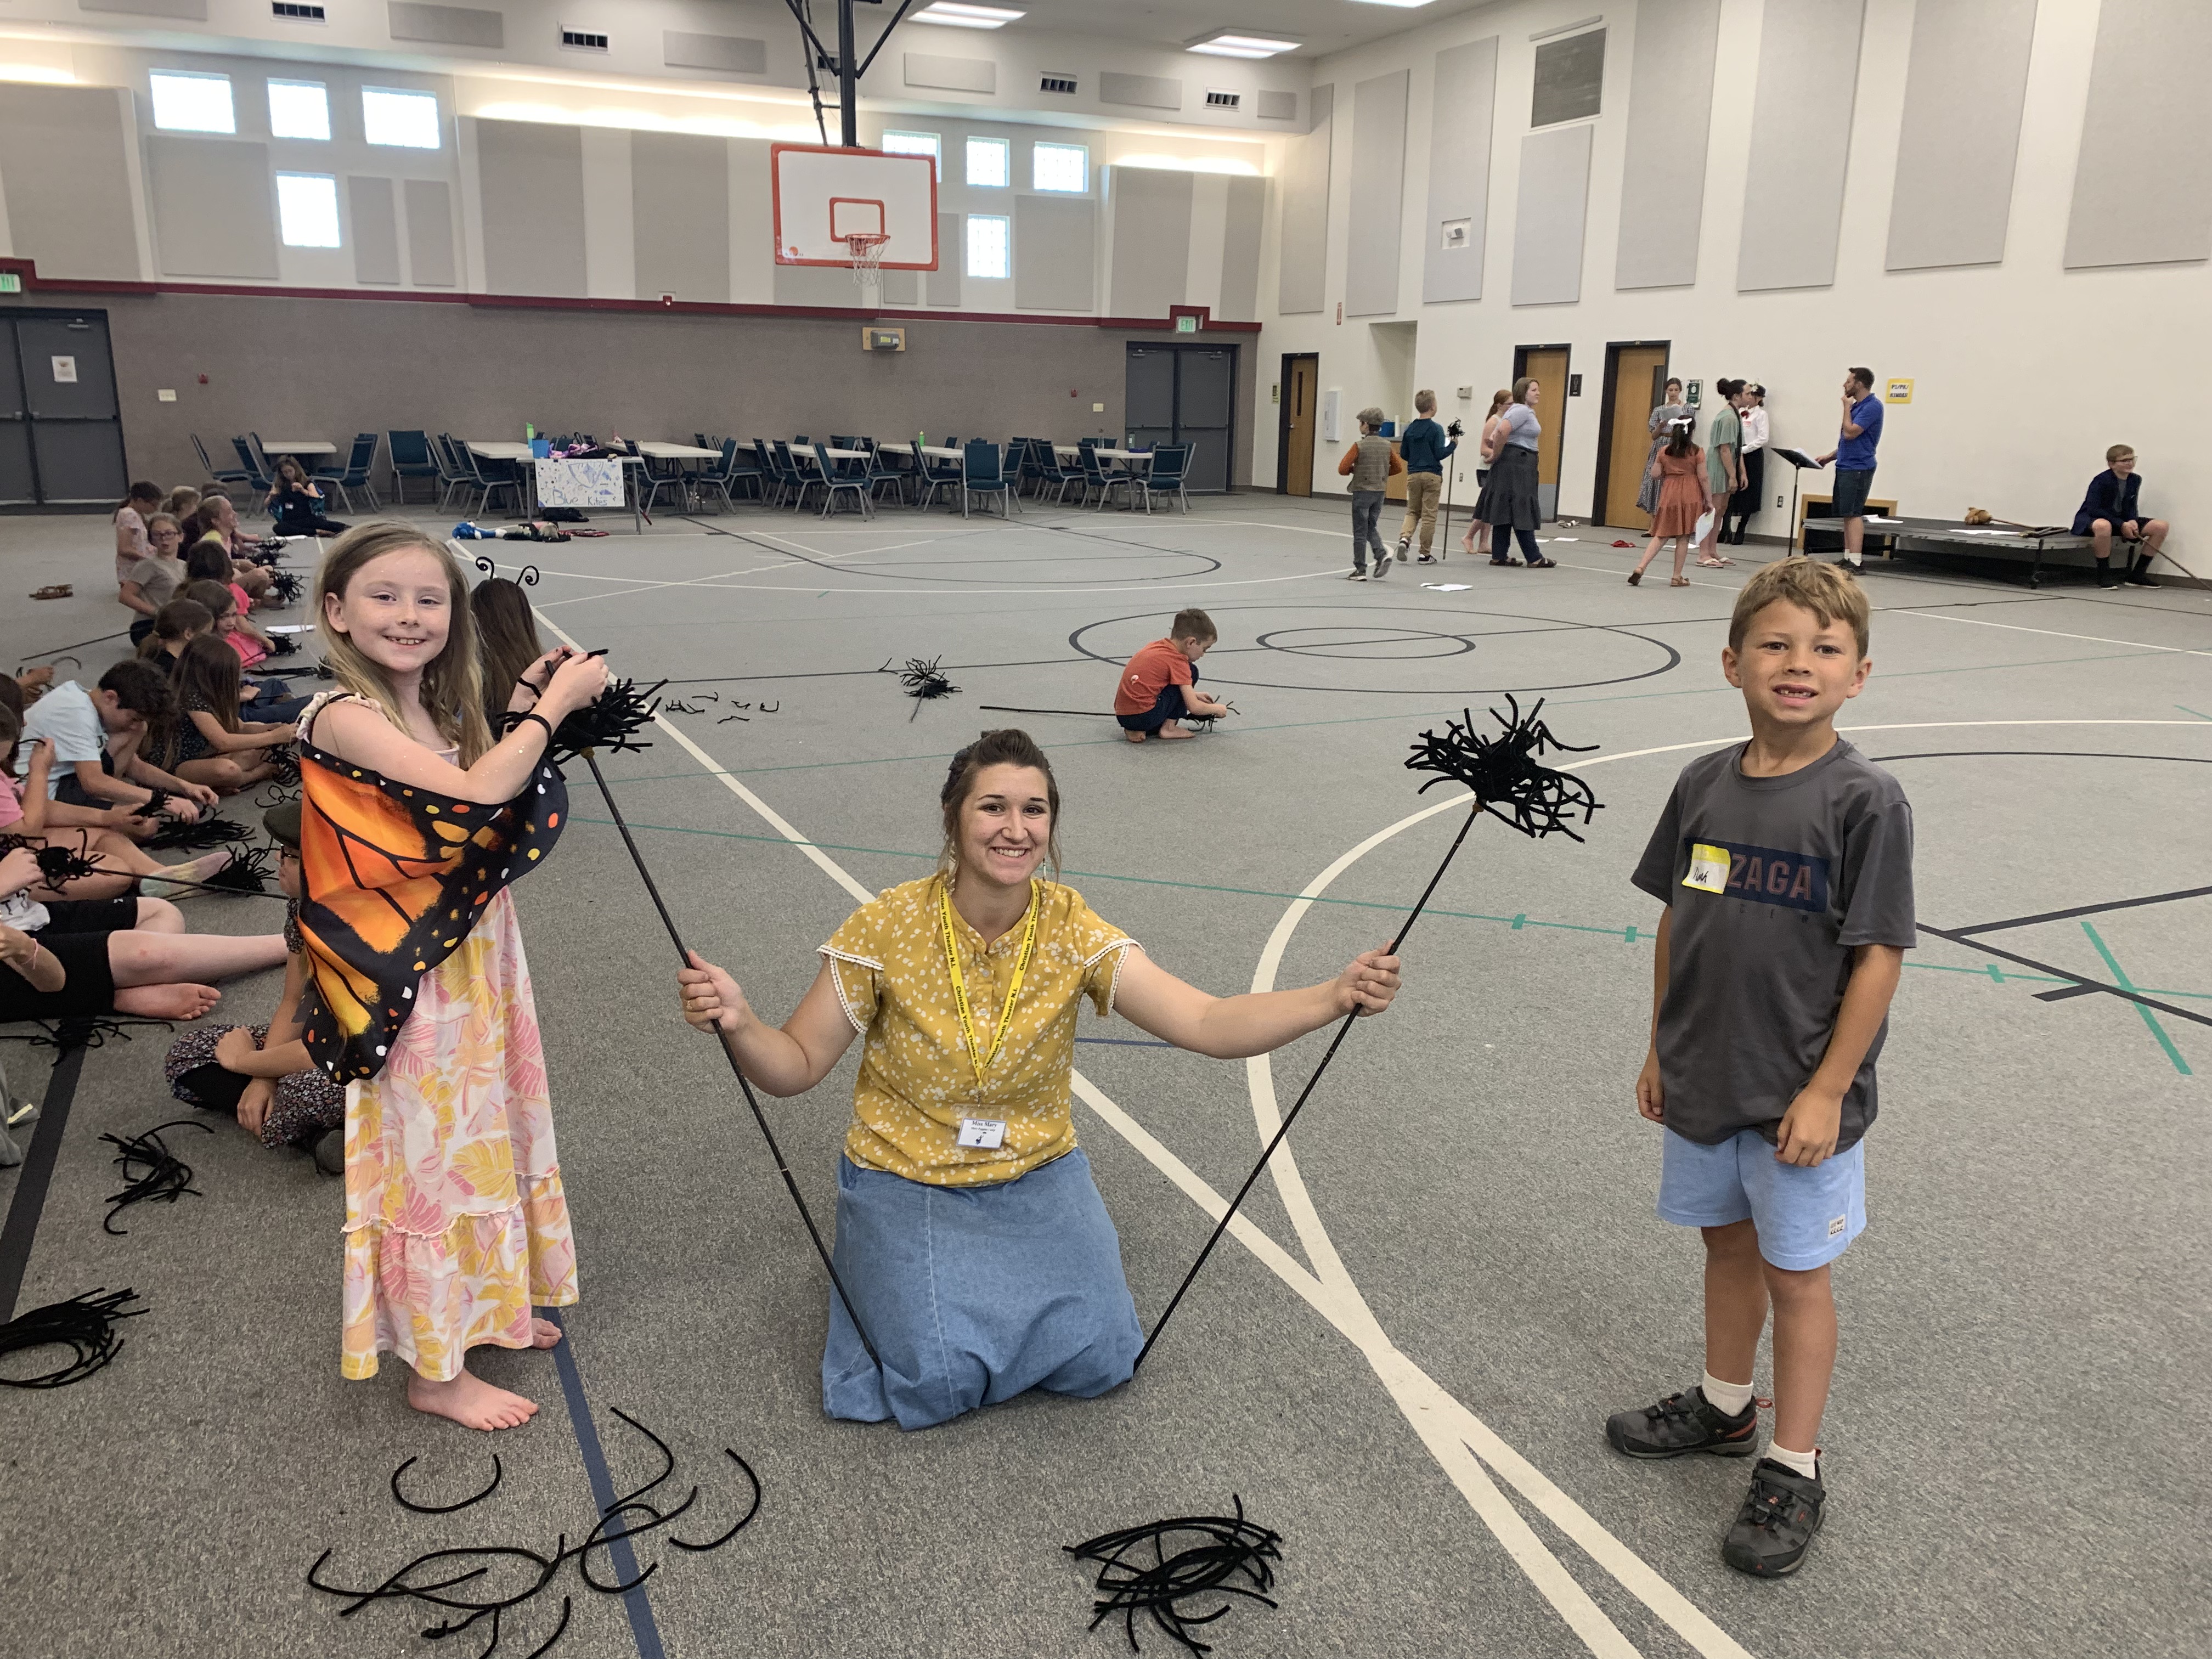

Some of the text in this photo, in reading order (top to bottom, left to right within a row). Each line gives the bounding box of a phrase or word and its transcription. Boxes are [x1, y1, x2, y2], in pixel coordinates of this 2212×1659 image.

[1181, 319, 1193, 330] EXIT
[552, 488, 607, 506] Blue Kites
[945, 931, 953, 956] Theater
[1019, 943, 1031, 971] Christian
[1026, 924, 1035, 941] Youth
[956, 986, 966, 1014] Christian
[968, 1034, 977, 1058] Theater
[996, 1025, 1007, 1042] Youth
[1003, 1000, 1014, 1023] Theater
